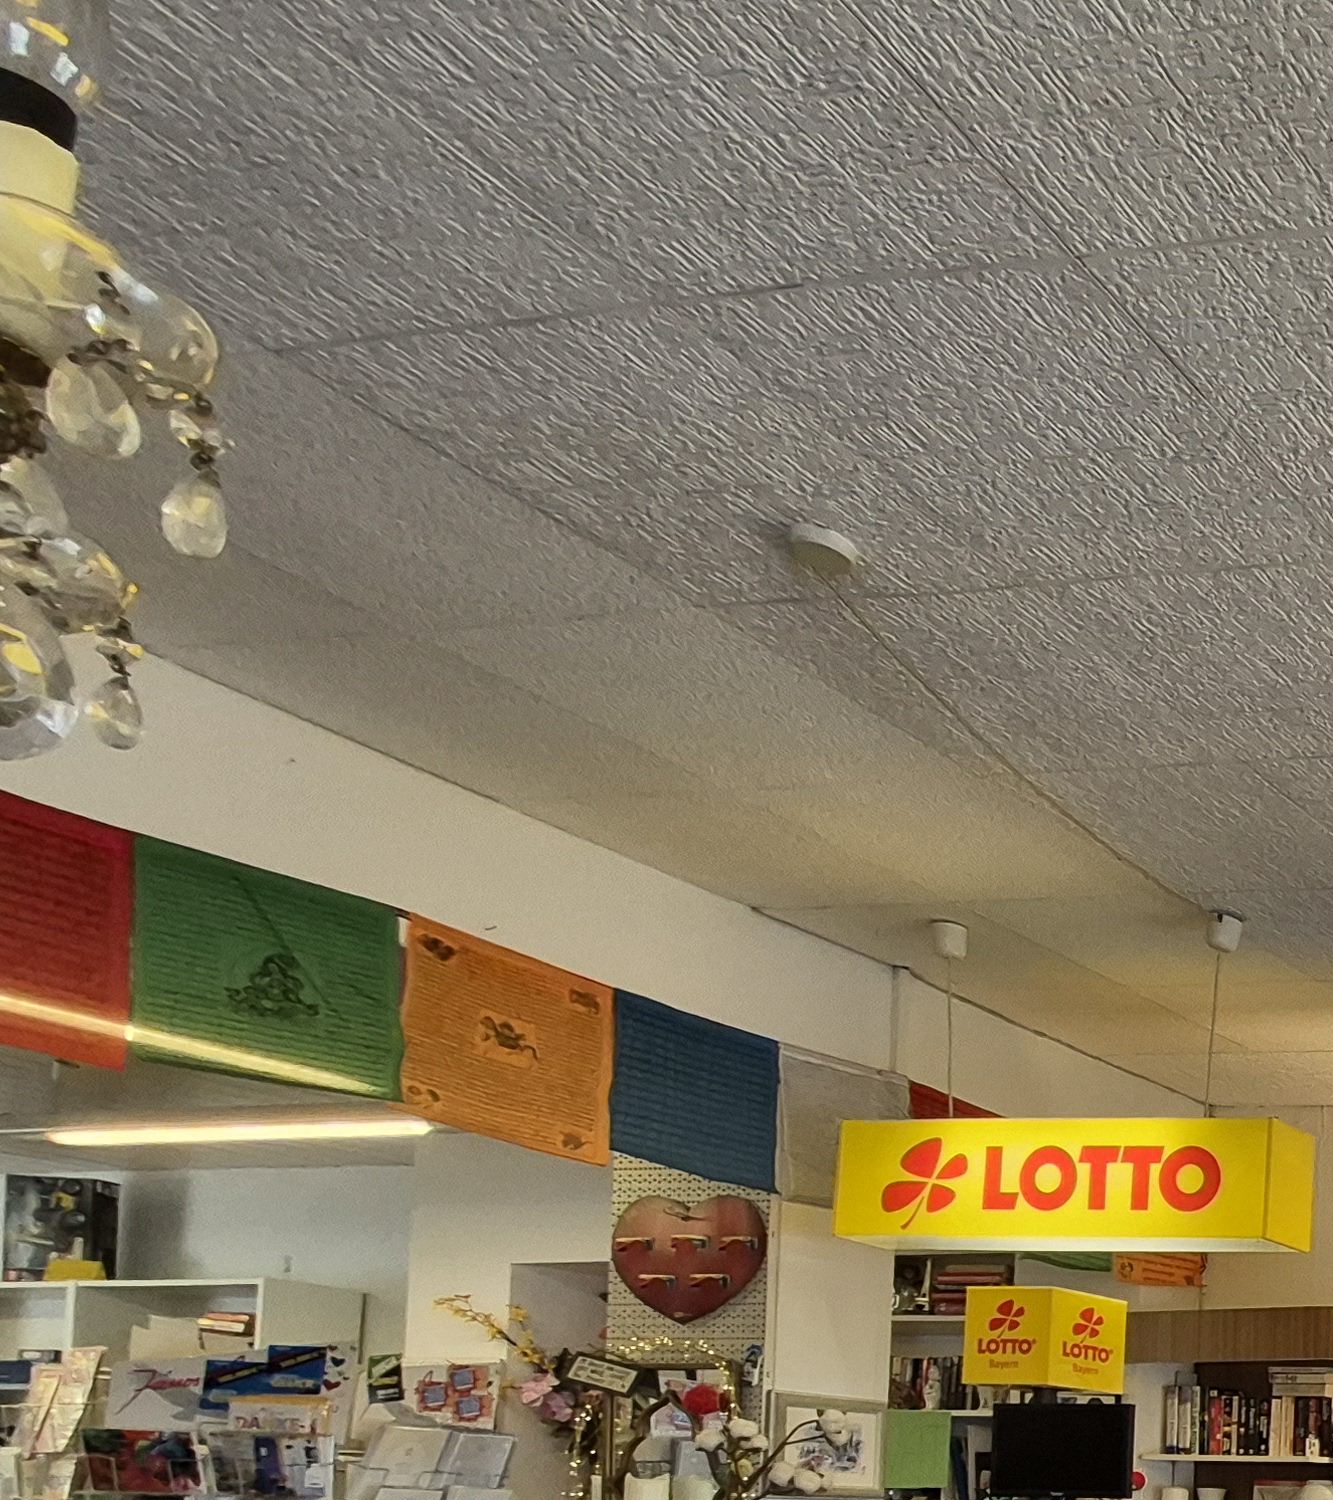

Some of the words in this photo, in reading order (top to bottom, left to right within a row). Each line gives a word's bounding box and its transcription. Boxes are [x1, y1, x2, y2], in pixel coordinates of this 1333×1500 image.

[982, 1145, 1221, 1212] LOTTO
[977, 1338, 1033, 1355] LOTTO
[1062, 1341, 1110, 1364] LOTTO
[989, 1359, 1019, 1370] Bayern
[1072, 1363, 1098, 1375] Bayern
